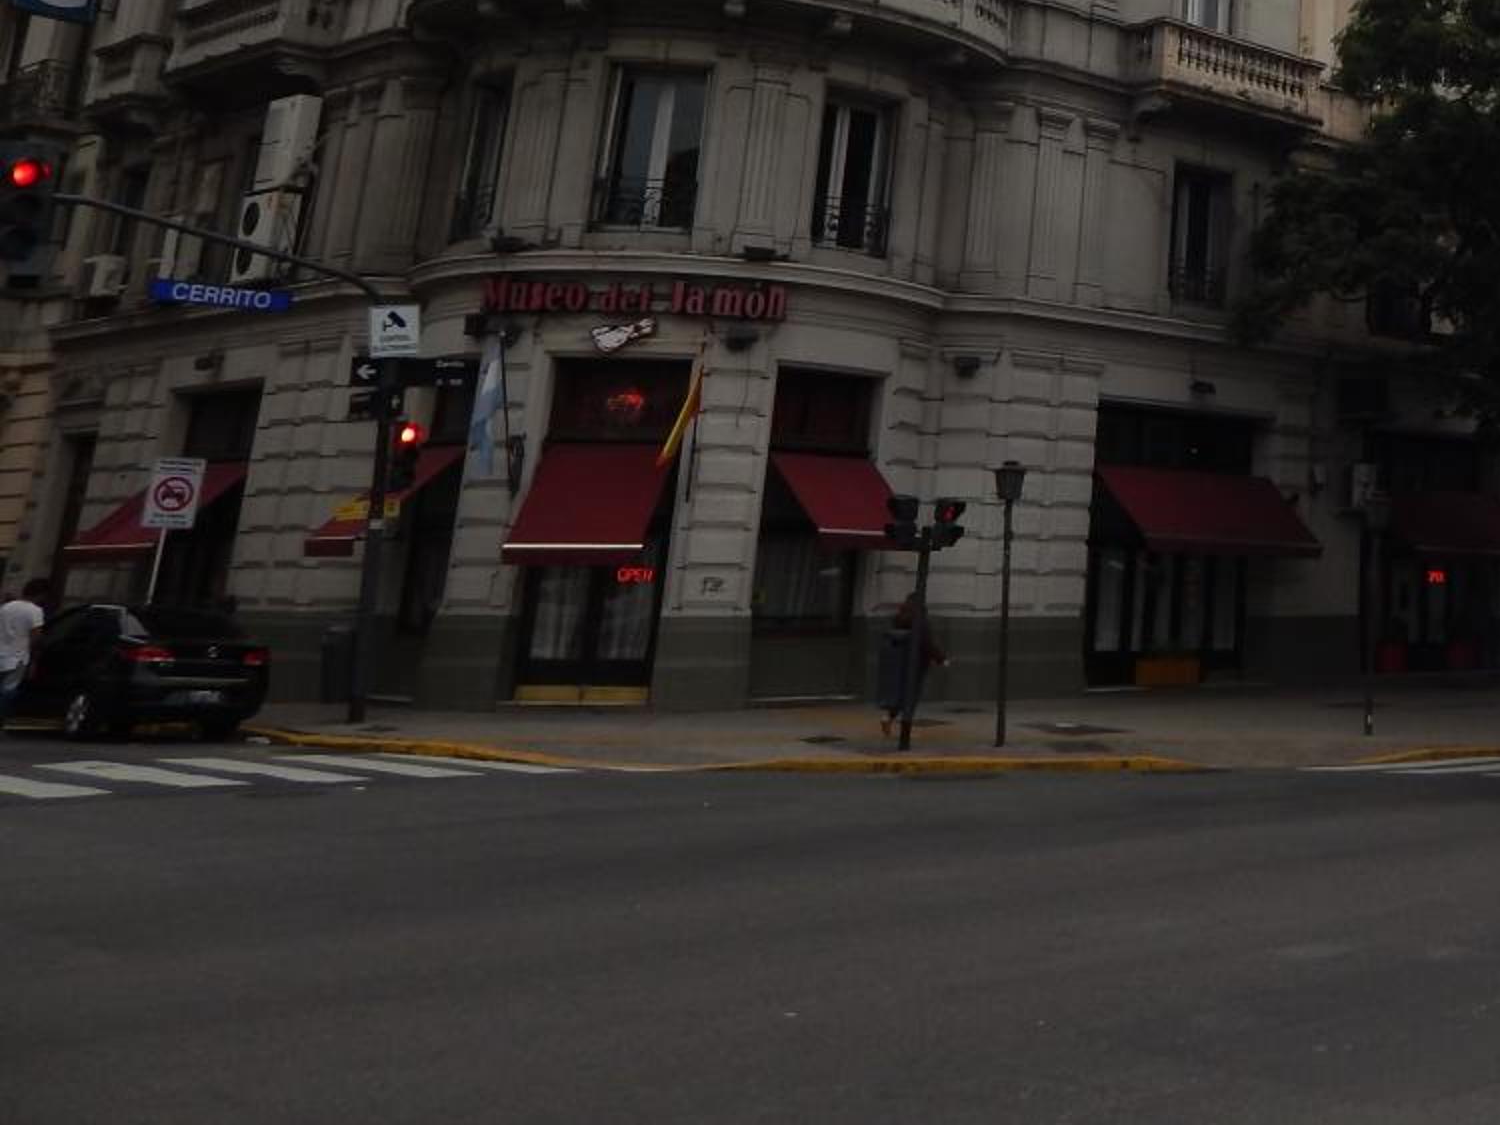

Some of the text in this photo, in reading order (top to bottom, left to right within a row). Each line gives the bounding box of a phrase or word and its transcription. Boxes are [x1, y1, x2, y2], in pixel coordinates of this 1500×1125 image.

[172, 282, 272, 308] CERRITO
[481, 276, 588, 312] Museo
[600, 282, 650, 312] del
